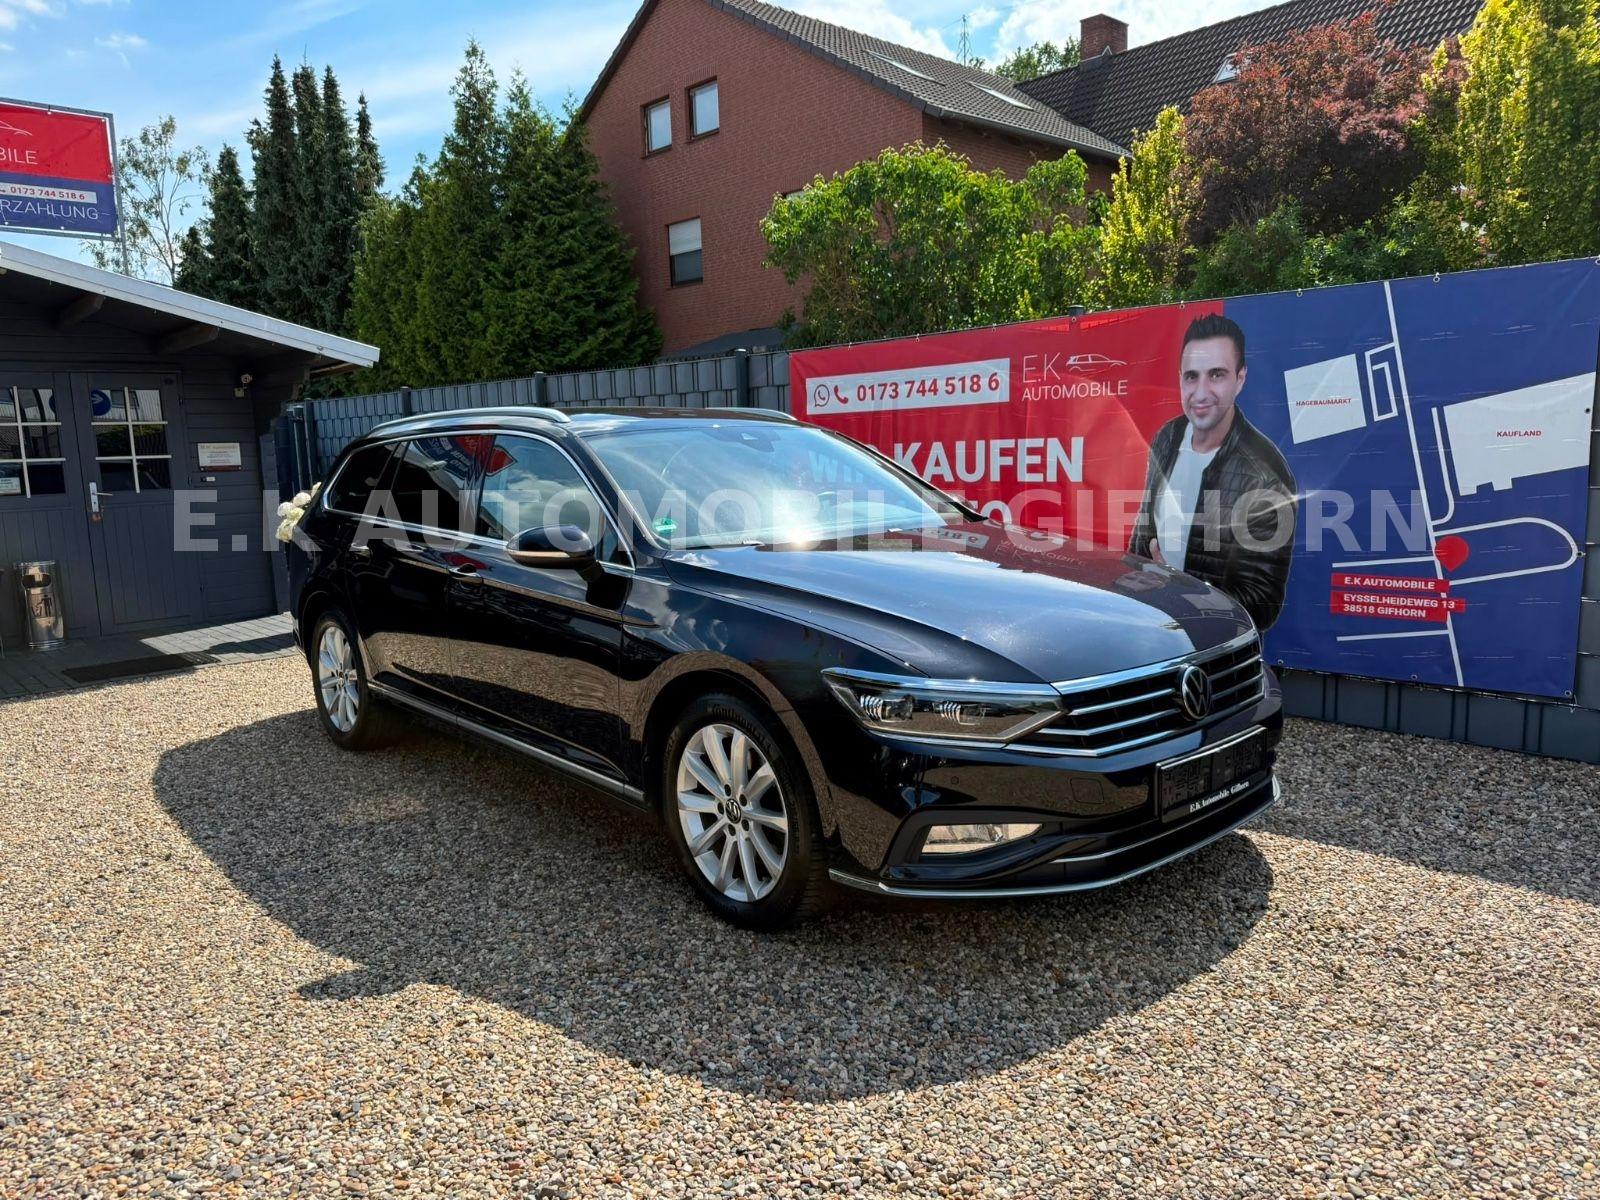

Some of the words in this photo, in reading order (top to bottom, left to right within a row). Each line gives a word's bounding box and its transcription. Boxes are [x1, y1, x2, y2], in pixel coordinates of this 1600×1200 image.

[10, 187, 35, 195] 0173
[38, 189, 56, 198] 744
[1023, 352, 1061, 383] E.K
[857, 382, 899, 402] 0173
[904, 377, 939, 399] 744
[945, 374, 981, 395] 518
[988, 372, 1000, 391] 6
[1021, 380, 1128, 401] AUTOMOBILE
[1296, 398, 1351, 407] HAGEBAUMARKT
[1497, 430, 1542, 438] KAUFLAND
[894, 437, 1084, 483] KAUFEN
[1344, 577, 1361, 585] E.K
[1363, 578, 1435, 590] AUTOMOBILE
[1344, 594, 1438, 608] EYSSELHEIDEWEG
[1442, 601, 1455, 609] 13
[1344, 604, 1375, 614] 38518
[1377, 607, 1426, 617] GIFHORN
